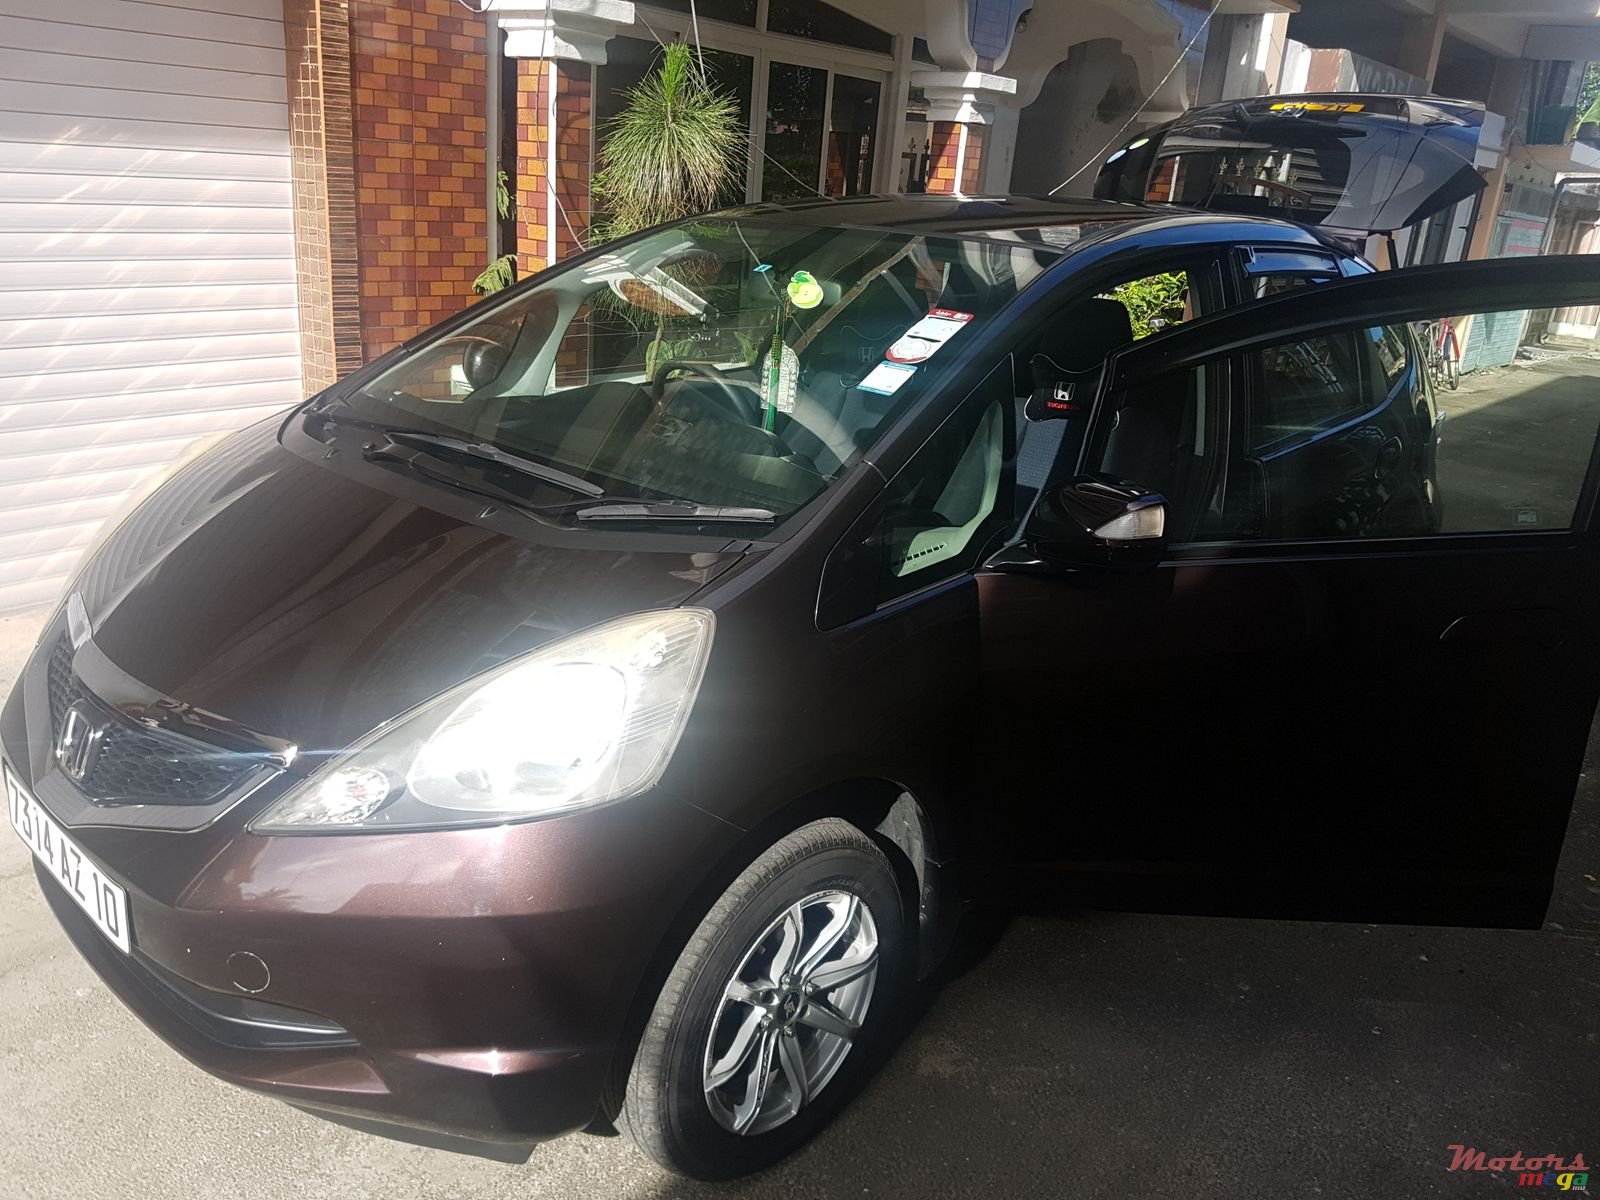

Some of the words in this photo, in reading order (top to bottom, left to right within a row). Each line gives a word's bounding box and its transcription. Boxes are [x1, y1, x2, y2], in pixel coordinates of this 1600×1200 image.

[9, 779, 54, 866] 7314
[61, 837, 86, 902] AZ
[93, 872, 120, 938] 10
